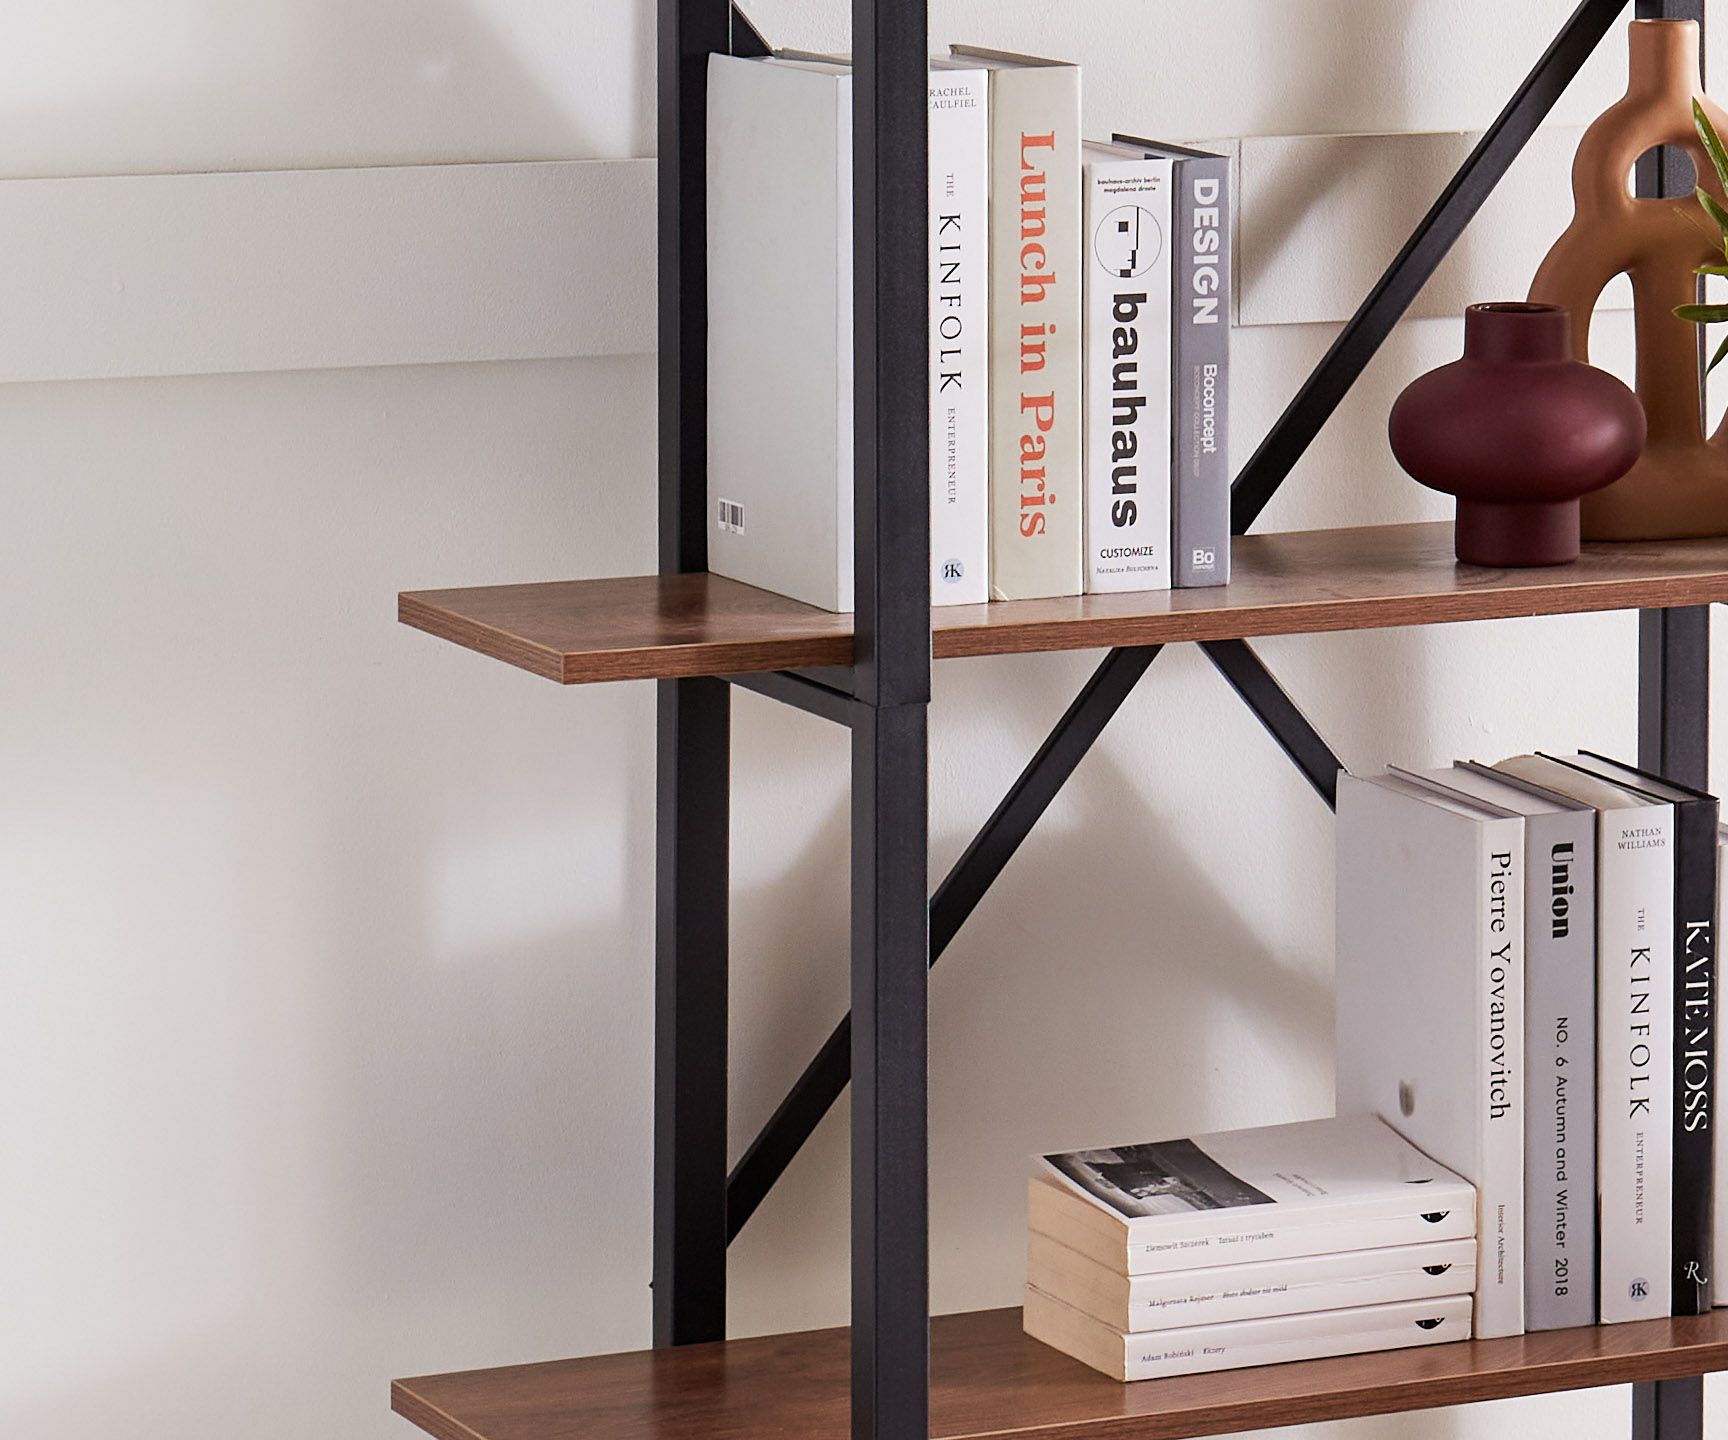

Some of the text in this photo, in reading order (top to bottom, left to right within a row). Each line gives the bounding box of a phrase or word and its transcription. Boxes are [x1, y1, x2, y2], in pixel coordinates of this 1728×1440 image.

[929, 87, 971, 97] RACHEL
[946, 173, 954, 198] THE
[1191, 178, 1220, 325] DESIGN
[939, 214, 962, 393] KINFOLK
[1020, 130, 1056, 538] Lunch in Paris
[1111, 292, 1148, 528] bauhaus
[1200, 363, 1219, 454] Boconcept
[1100, 546, 1154, 559] CUSTOMIZE
[1192, 549, 1216, 565] Bo
[1617, 839, 1666, 850] WILLIAMS
[1621, 827, 1662, 839] NATHAN
[1551, 841, 1575, 939] Union
[1637, 908, 1645, 932] THE
[1490, 851, 1512, 1120] Pierre Yovanovitch
[1629, 947, 1651, 1119] KINFOLK
[1555, 1017, 1569, 1297] NO. 6 Autumn and Winter 2018
[1141, 1354, 1162, 1363] Adam
